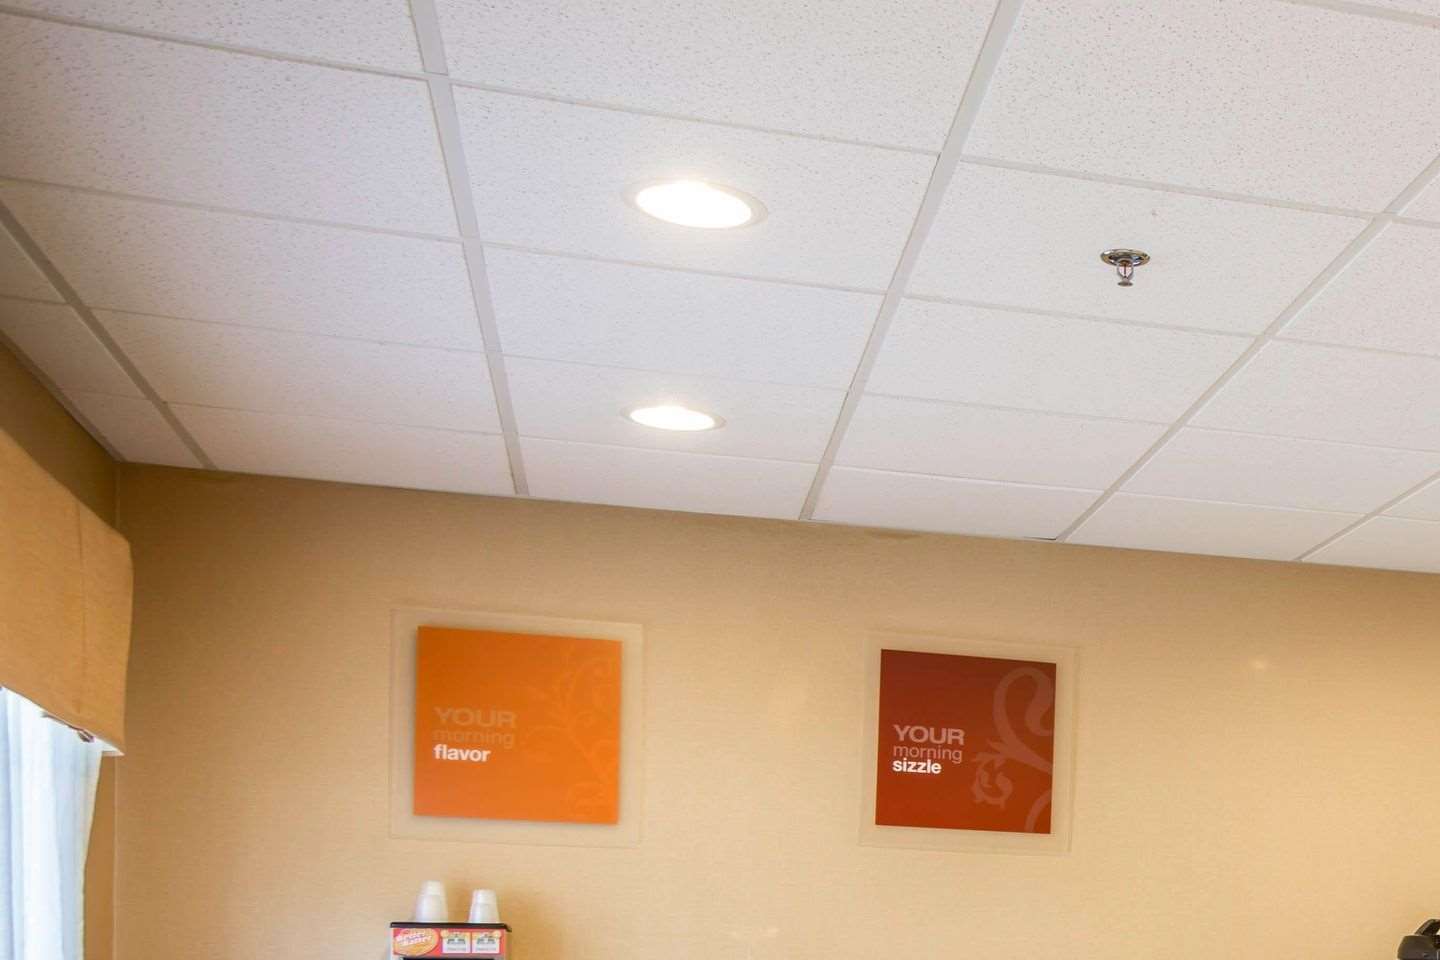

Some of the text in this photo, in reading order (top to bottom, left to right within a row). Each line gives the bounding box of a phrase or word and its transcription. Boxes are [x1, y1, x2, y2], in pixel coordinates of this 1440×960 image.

[433, 706, 517, 728] YOUR
[433, 728, 515, 751] morning
[893, 724, 965, 746] YOUR
[432, 743, 492, 763] flavor
[892, 744, 963, 765] morning
[892, 757, 942, 774] sizzle
